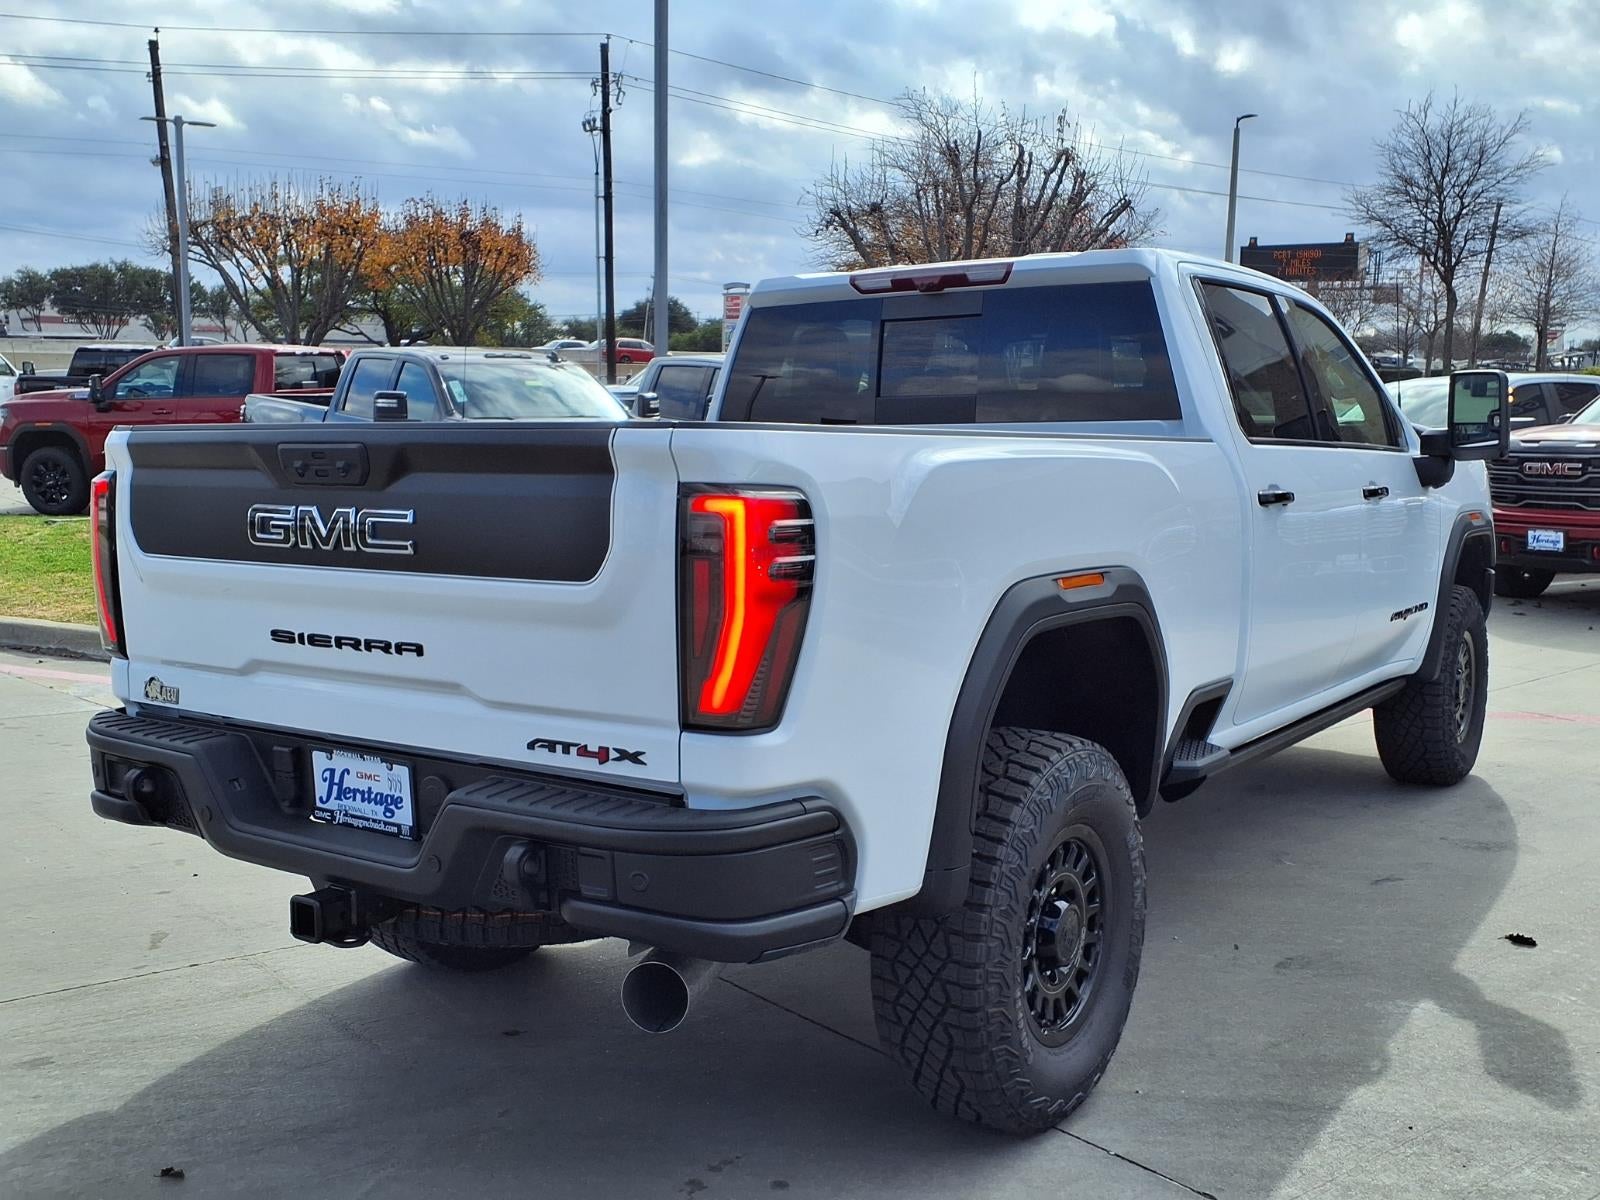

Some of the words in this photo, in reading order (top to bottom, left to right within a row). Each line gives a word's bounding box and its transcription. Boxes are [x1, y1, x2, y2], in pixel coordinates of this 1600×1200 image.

[1290, 258, 1311, 267] MILES
[1523, 462, 1582, 475] GMC
[248, 503, 416, 555] GMC
[270, 629, 425, 657] SIERRA
[526, 737, 647, 766] AT4X
[356, 771, 381, 783] GMC
[319, 767, 404, 819] Heritage
[314, 810, 332, 820] GMC
